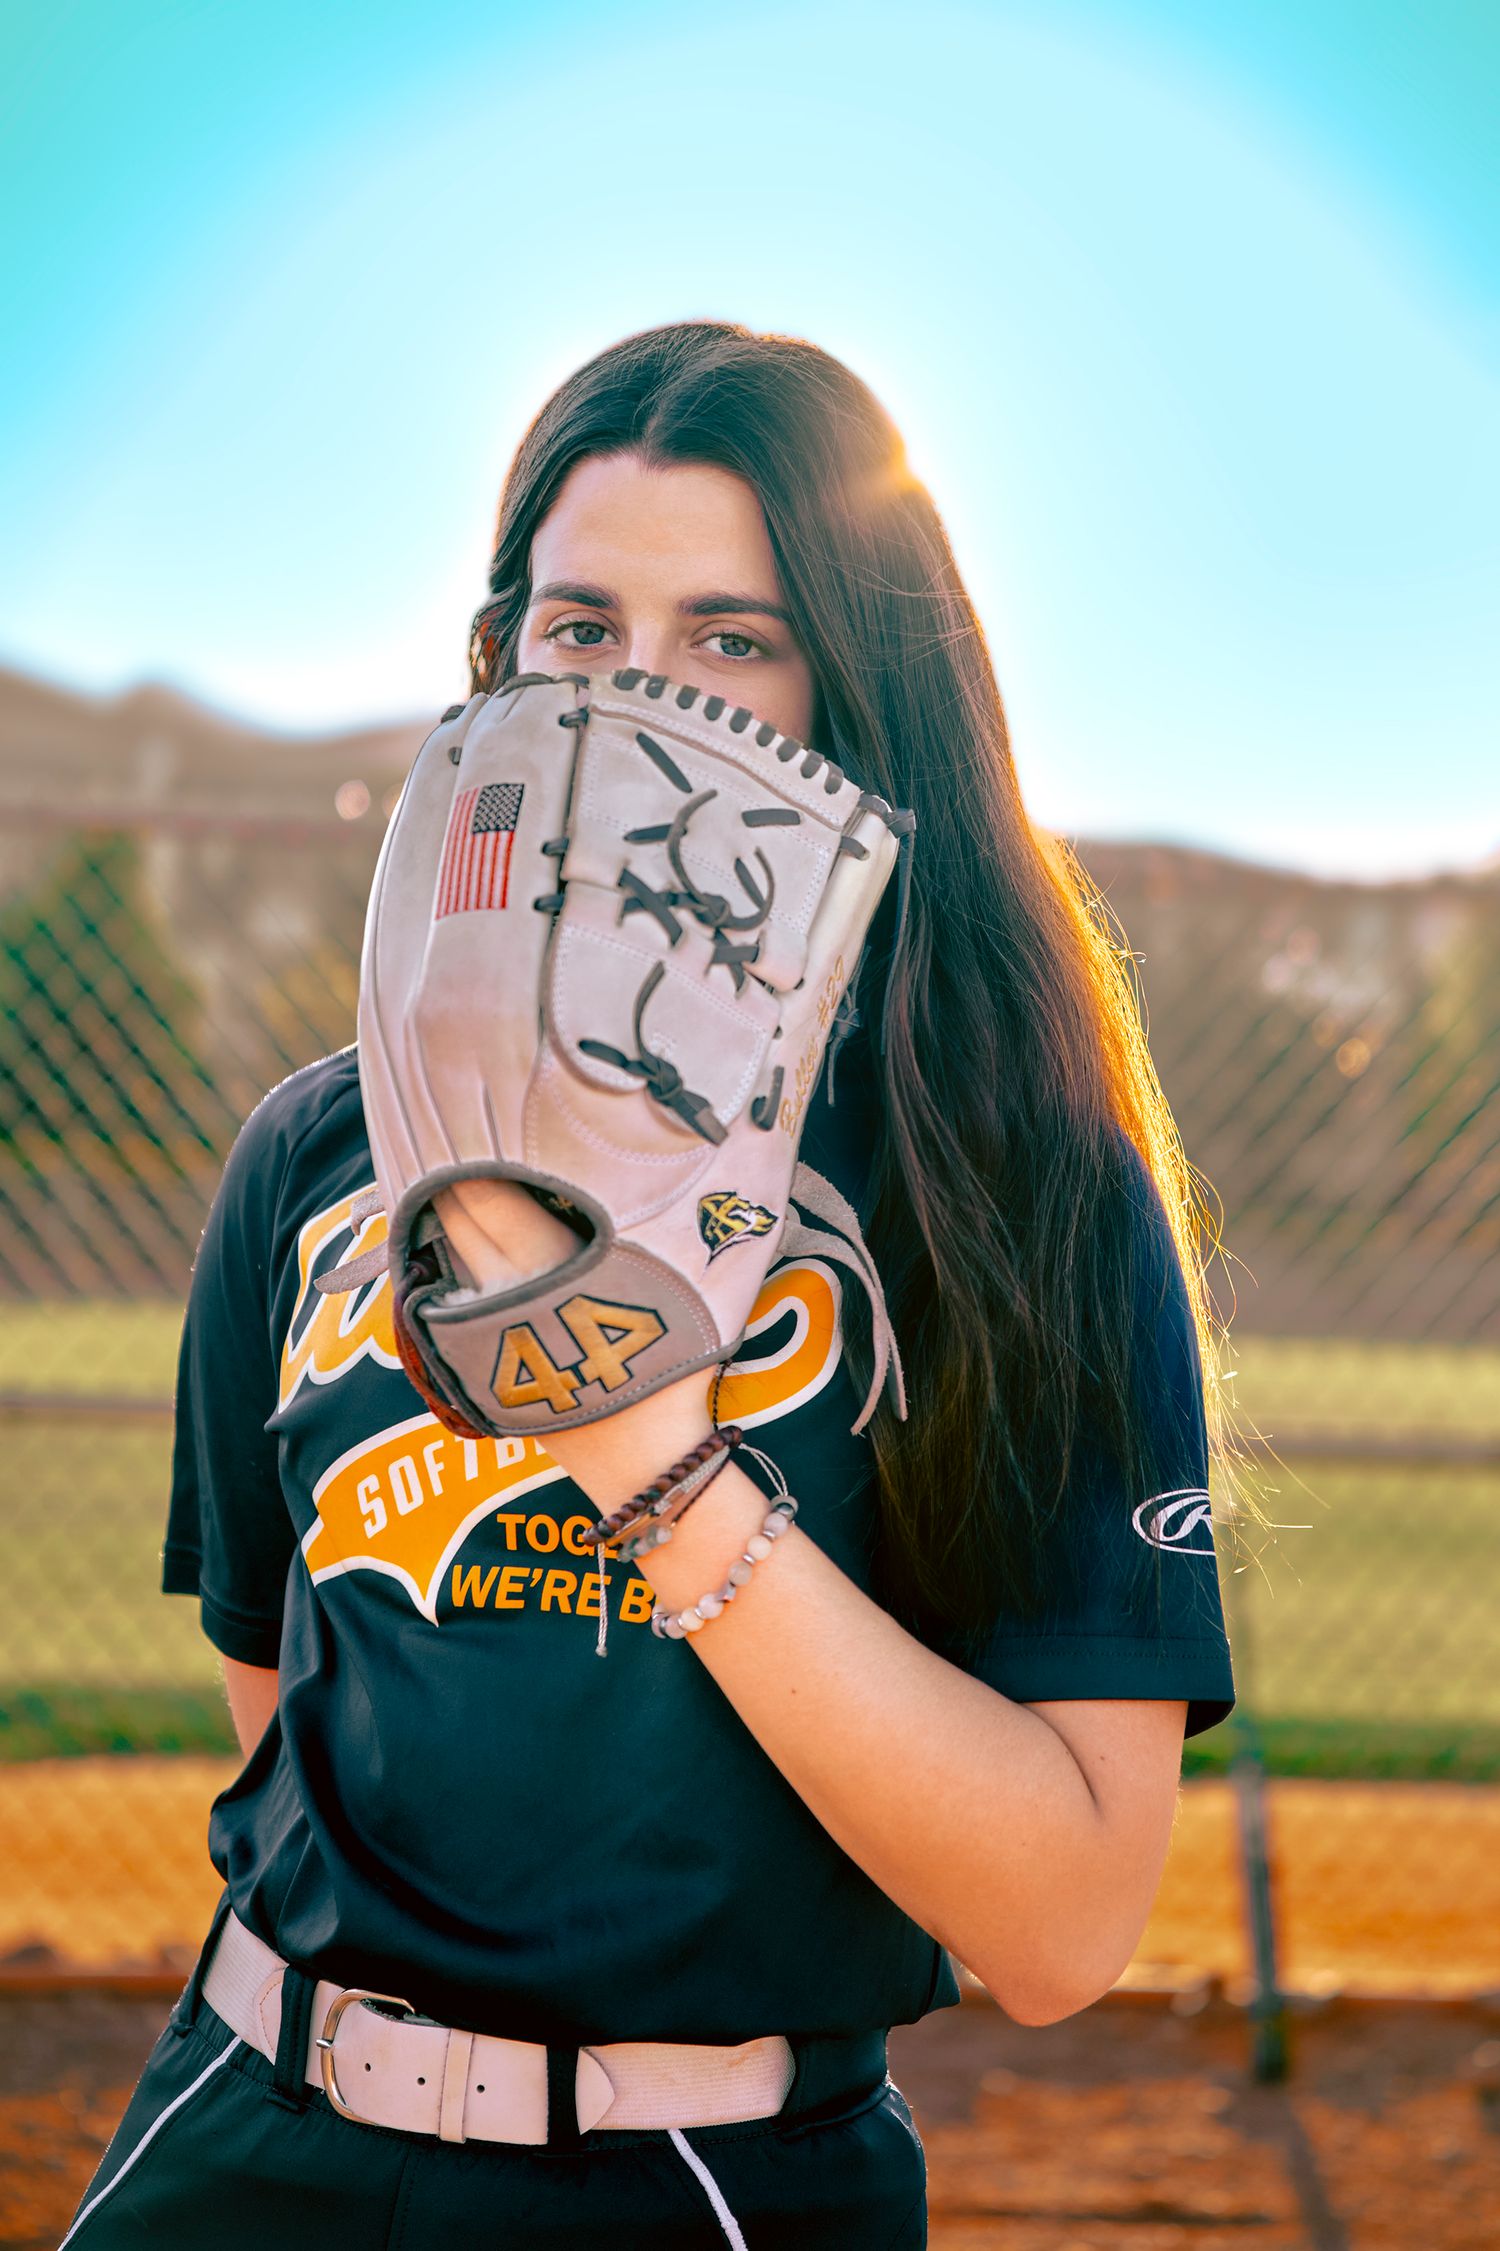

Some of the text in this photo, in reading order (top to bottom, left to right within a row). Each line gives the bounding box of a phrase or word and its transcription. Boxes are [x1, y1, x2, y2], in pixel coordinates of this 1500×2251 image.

[489, 1293, 669, 1414] 44
[356, 1435, 547, 1539] SOFTB
[496, 1513, 619, 1559] TOG
[451, 1565, 612, 1617] WE'RE
